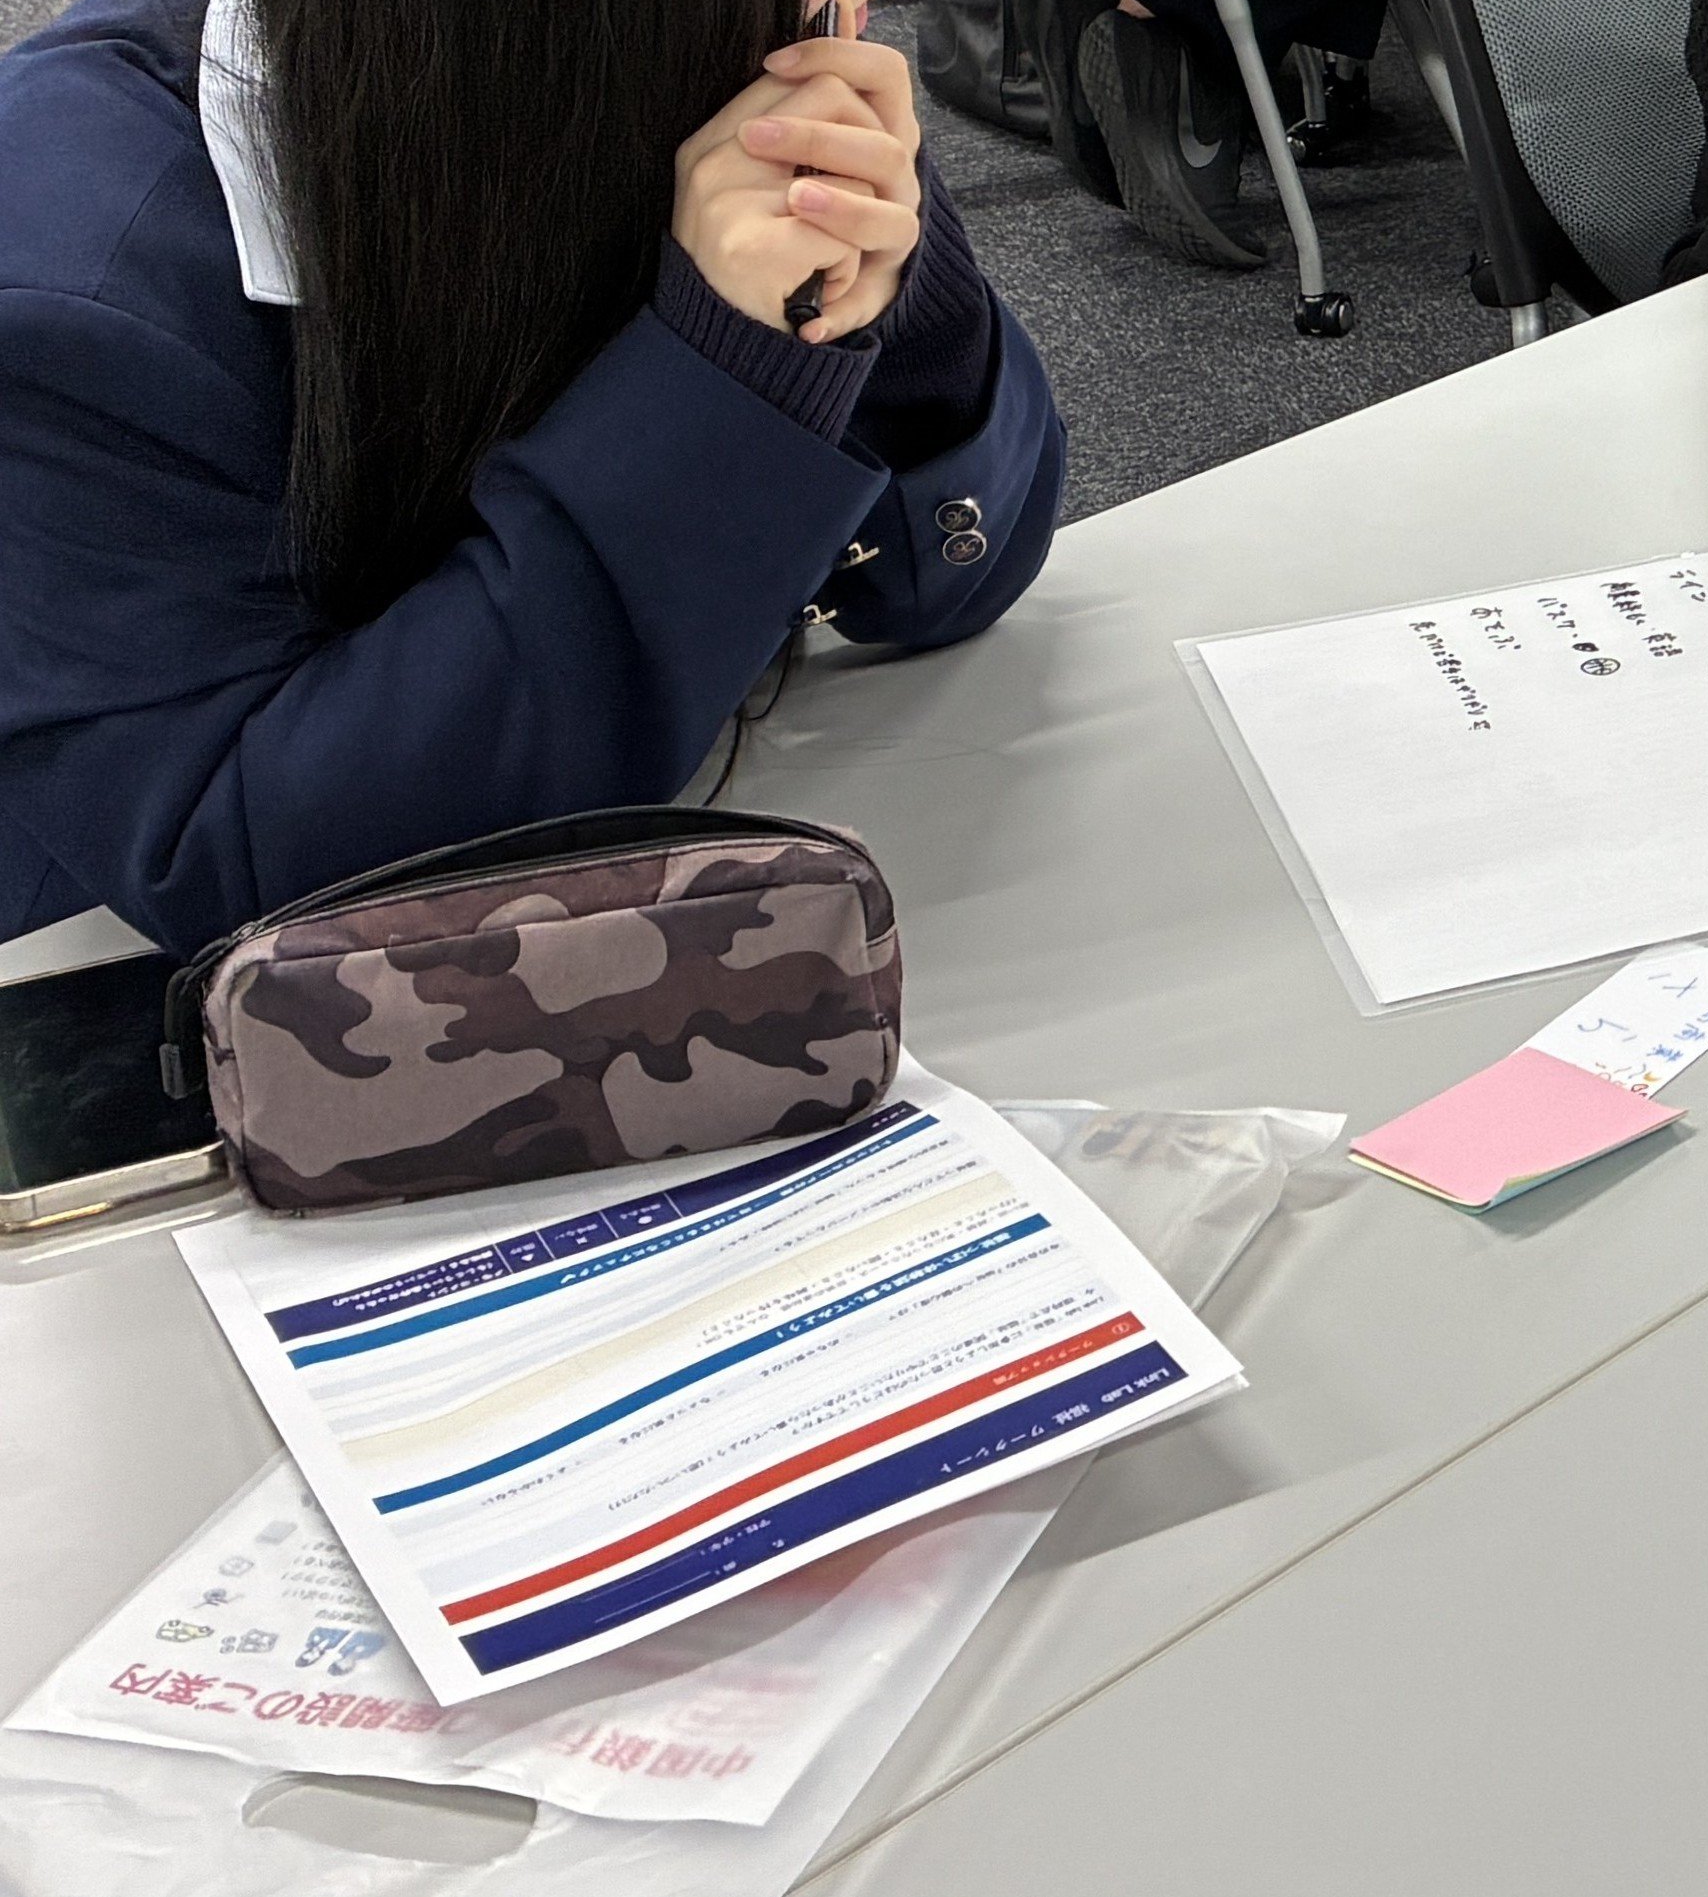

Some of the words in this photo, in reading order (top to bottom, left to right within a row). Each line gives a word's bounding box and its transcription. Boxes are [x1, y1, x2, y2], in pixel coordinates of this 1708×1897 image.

[1669, 569, 1707, 603] ライン
[1133, 1367, 1170, 1388] Link
[1101, 1384, 1134, 1403] Lab
